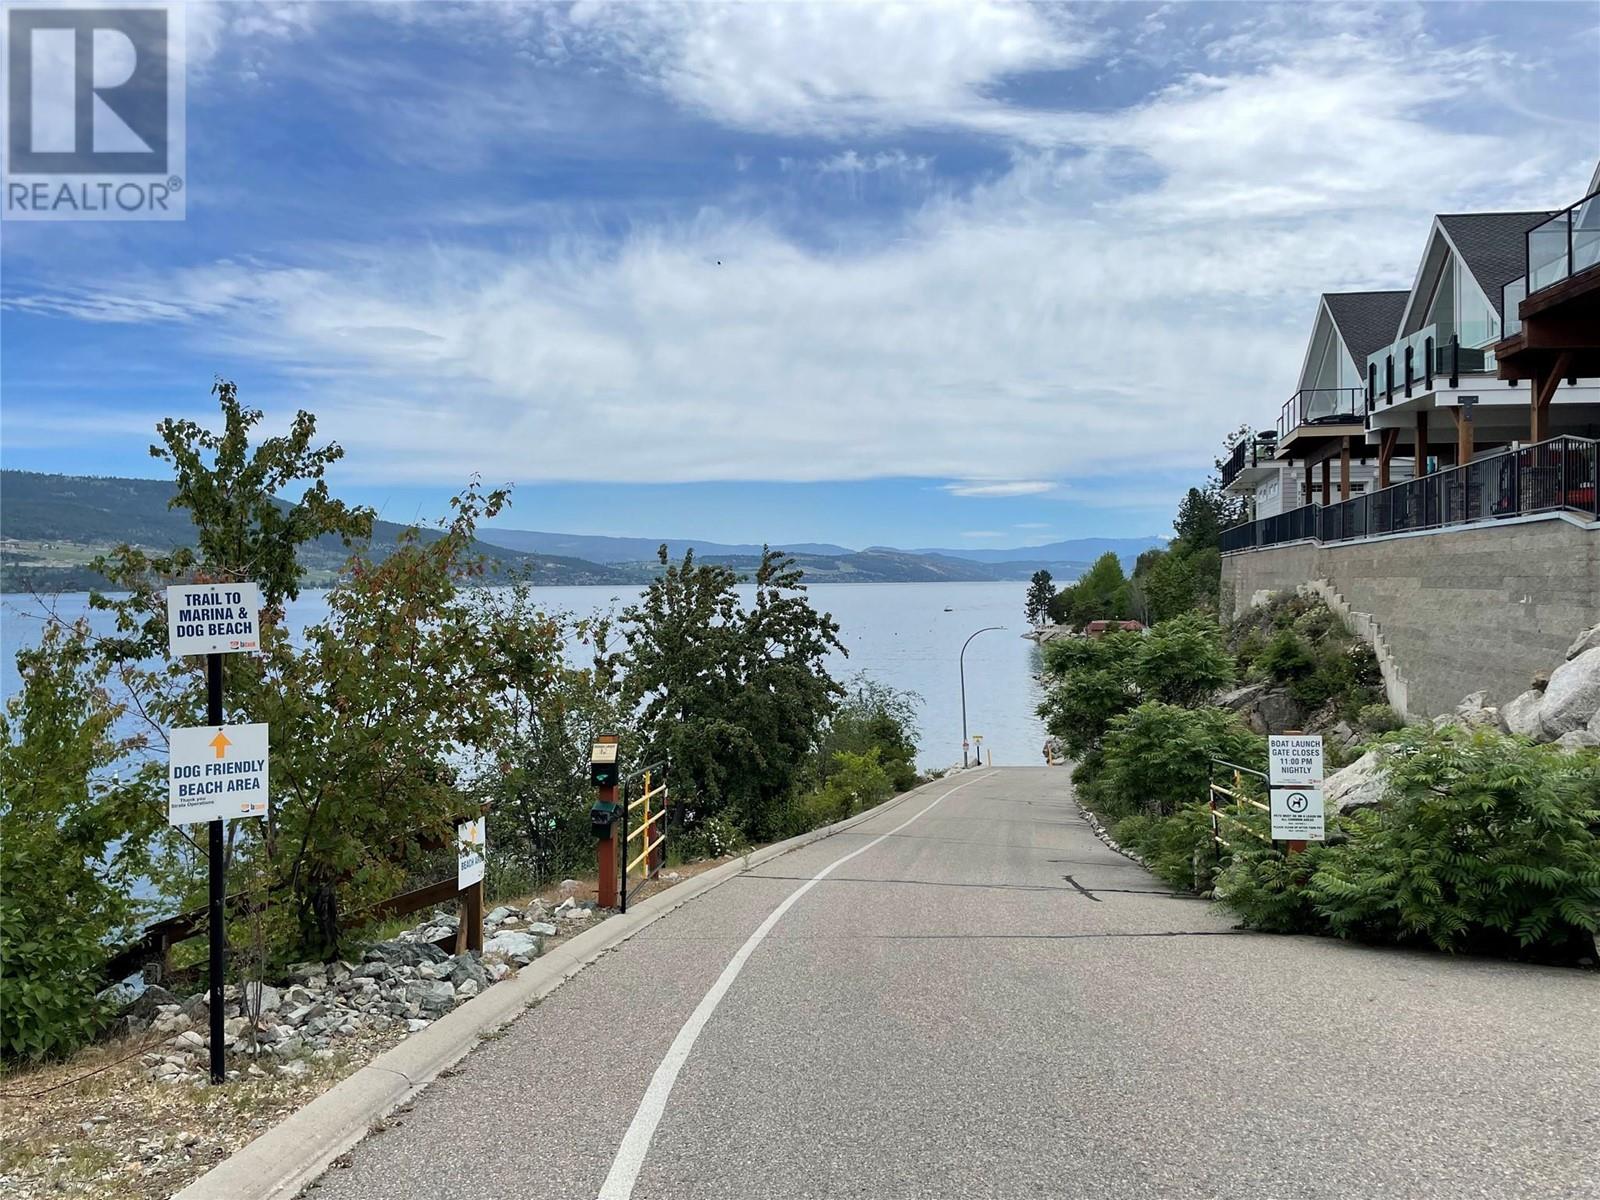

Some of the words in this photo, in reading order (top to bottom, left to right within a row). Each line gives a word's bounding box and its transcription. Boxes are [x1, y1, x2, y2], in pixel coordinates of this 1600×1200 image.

[185, 593, 222, 606] TRAIL
[225, 592, 241, 604] TO
[179, 607, 234, 622] MARINA
[238, 607, 248, 619] &
[177, 624, 204, 638] DOG
[208, 621, 252, 636] BEACH
[1291, 740, 1320, 748] LAUNCH
[174, 765, 201, 779] DOG
[205, 760, 264, 776] FRIENDLY
[1281, 766, 1312, 774] NIGHTLY
[179, 780, 223, 797] BEACH
[226, 777, 260, 792] AREA
